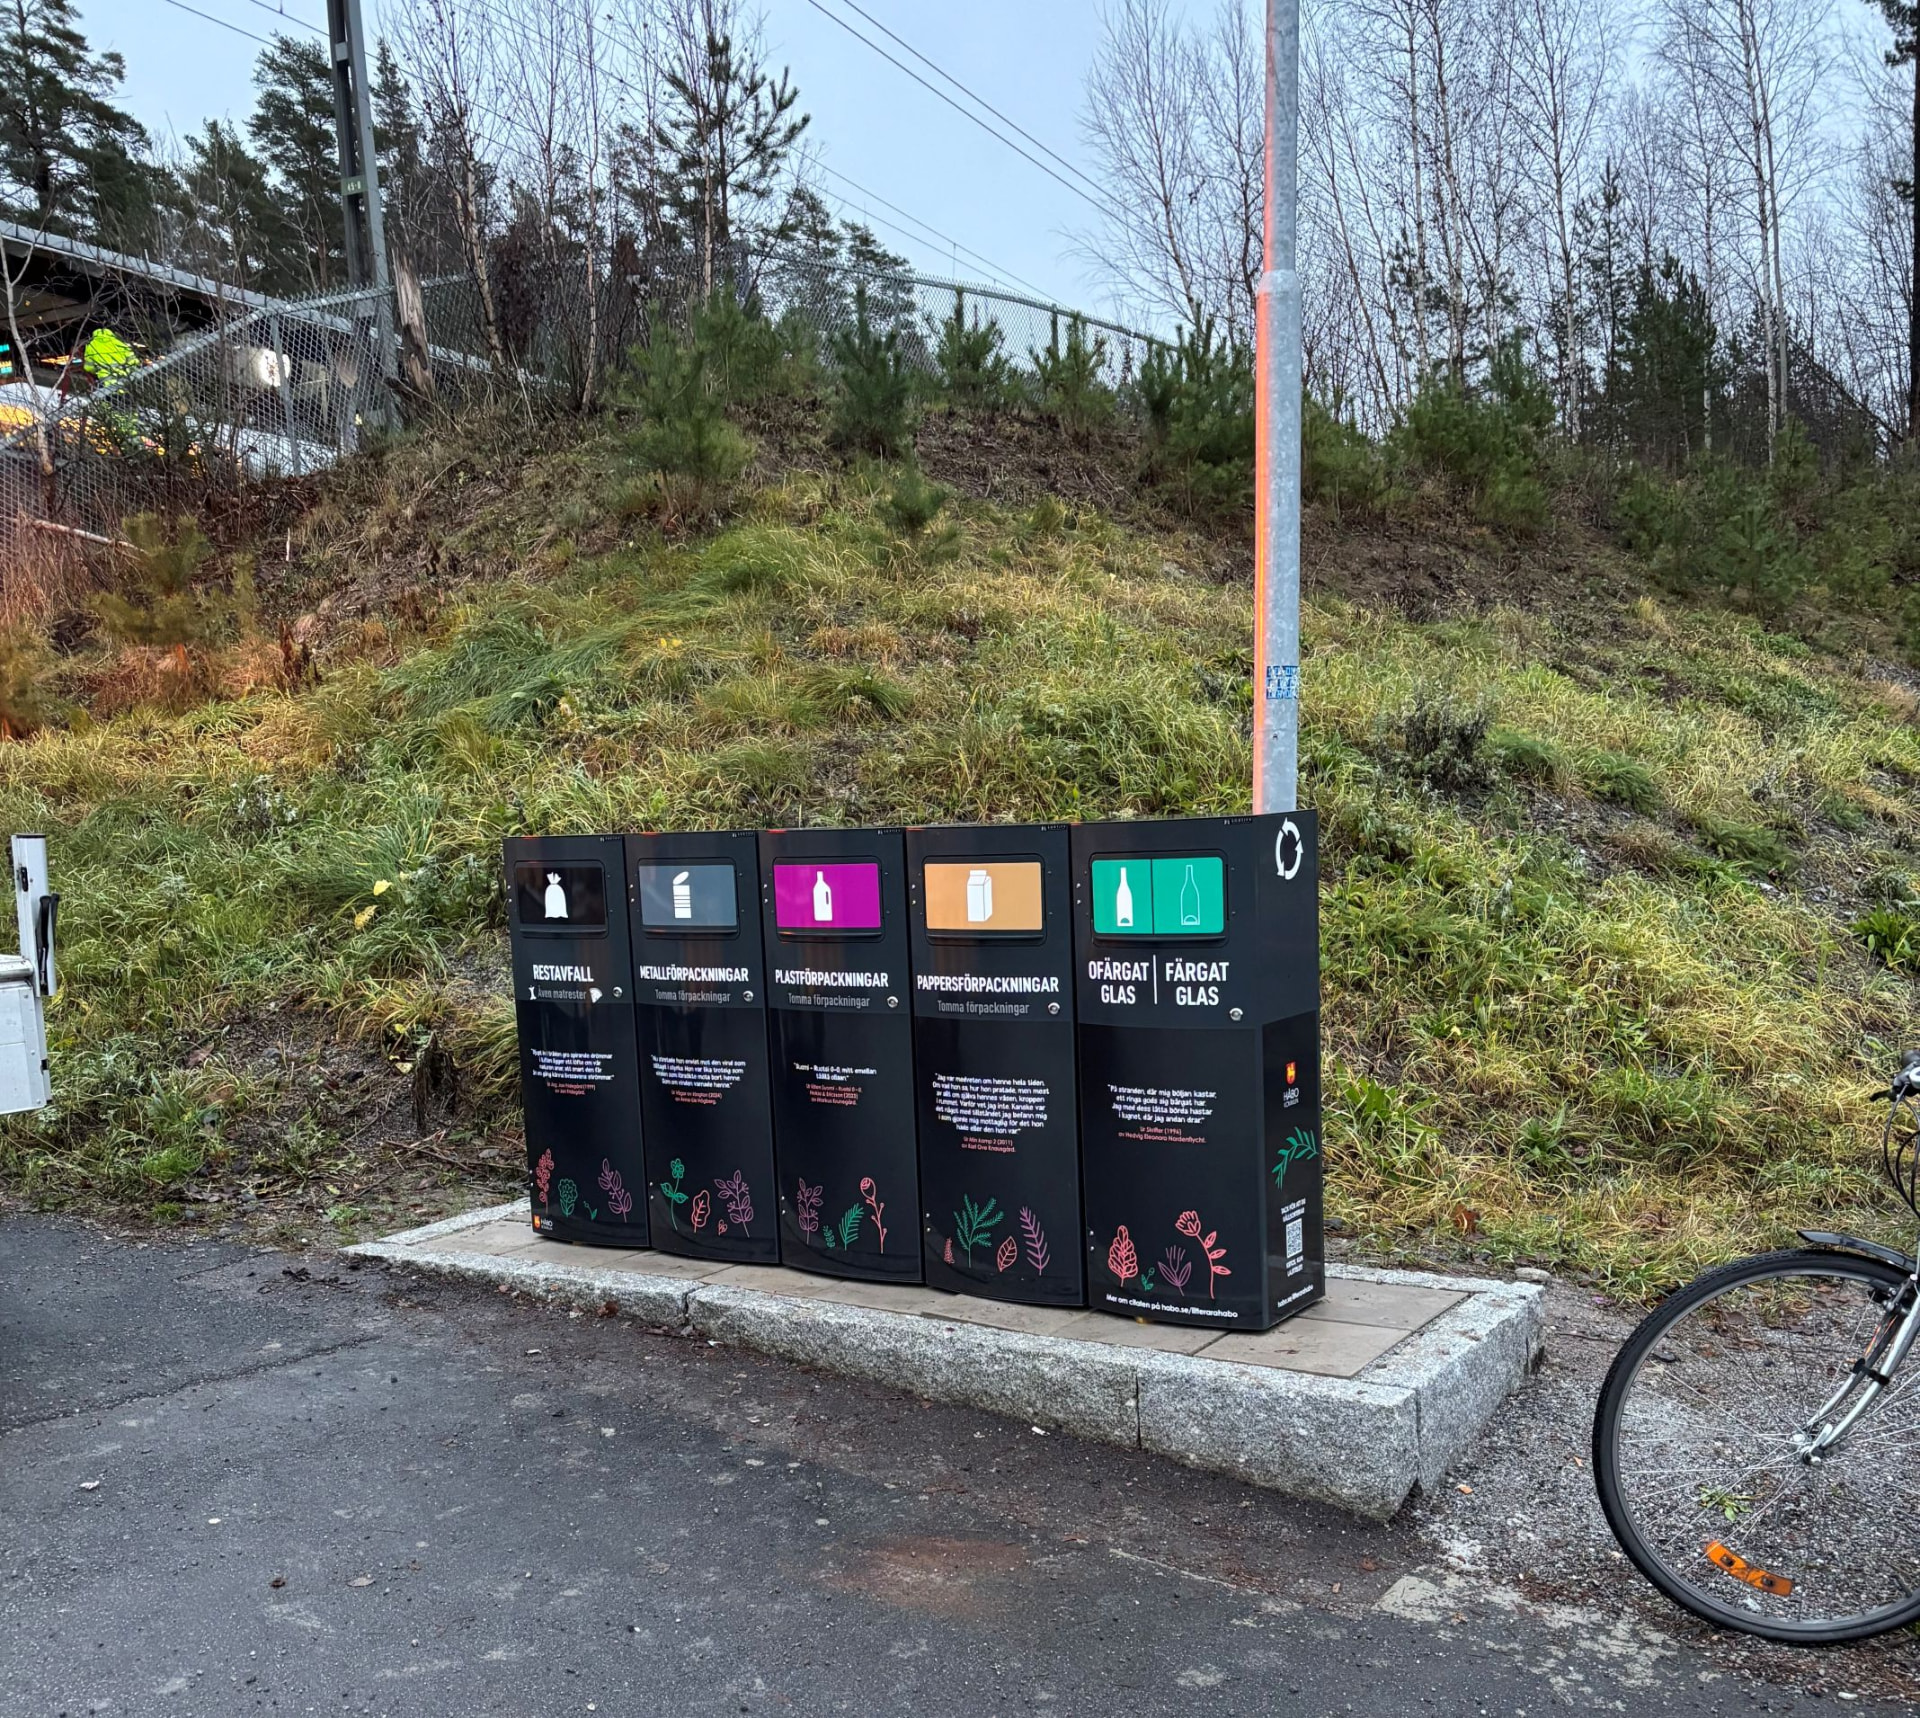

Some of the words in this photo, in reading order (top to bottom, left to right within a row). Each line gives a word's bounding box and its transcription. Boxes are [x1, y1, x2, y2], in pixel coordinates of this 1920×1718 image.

[533, 964, 594, 982] RESTAVFALL
[640, 964, 749, 982] METALLFÖRPACKNINGAR
[1088, 957, 1149, 981] OFÄRGAT
[1166, 958, 1229, 981] FÄRGAT
[775, 968, 889, 987] PLASTFÖRPACKNINGAR
[917, 974, 1059, 993] PAPPERSFÖRPACKNINGAR
[538, 985, 551, 998] Även
[553, 989, 586, 999] matrester
[655, 989, 677, 1000] Tomma
[678, 990, 731, 1003] förpackningar
[1101, 985, 1136, 1004] GLAS
[1176, 986, 1219, 1005] GLAS
[788, 993, 812, 1005] Tomma
[813, 994, 870, 1008] förpackningar
[938, 1000, 964, 1012] Tomma
[966, 1001, 1030, 1016] förpackningar
[1158, 1089, 1170, 1097] mig
[987, 1102, 996, 1110] jag
[1112, 1103, 1121, 1111] Jag
[1169, 1107, 1188, 1115] börda
[1126, 1096, 1141, 1104] ringa
[1159, 1098, 1168, 1106] sig
[1170, 1099, 1192, 1108] bärgat
[969, 1117, 979, 1125] mig
[980, 1118, 1007, 1127] mottaglig
[1002, 1111, 1011, 1119] jag
[1154, 1114, 1164, 1123] jag
[1125, 1132, 1143, 1140] Hedvig
[1106, 1294, 1117, 1302] Mer
[1129, 1299, 1150, 1308] citaten
[1151, 1302, 1160, 1310] på
